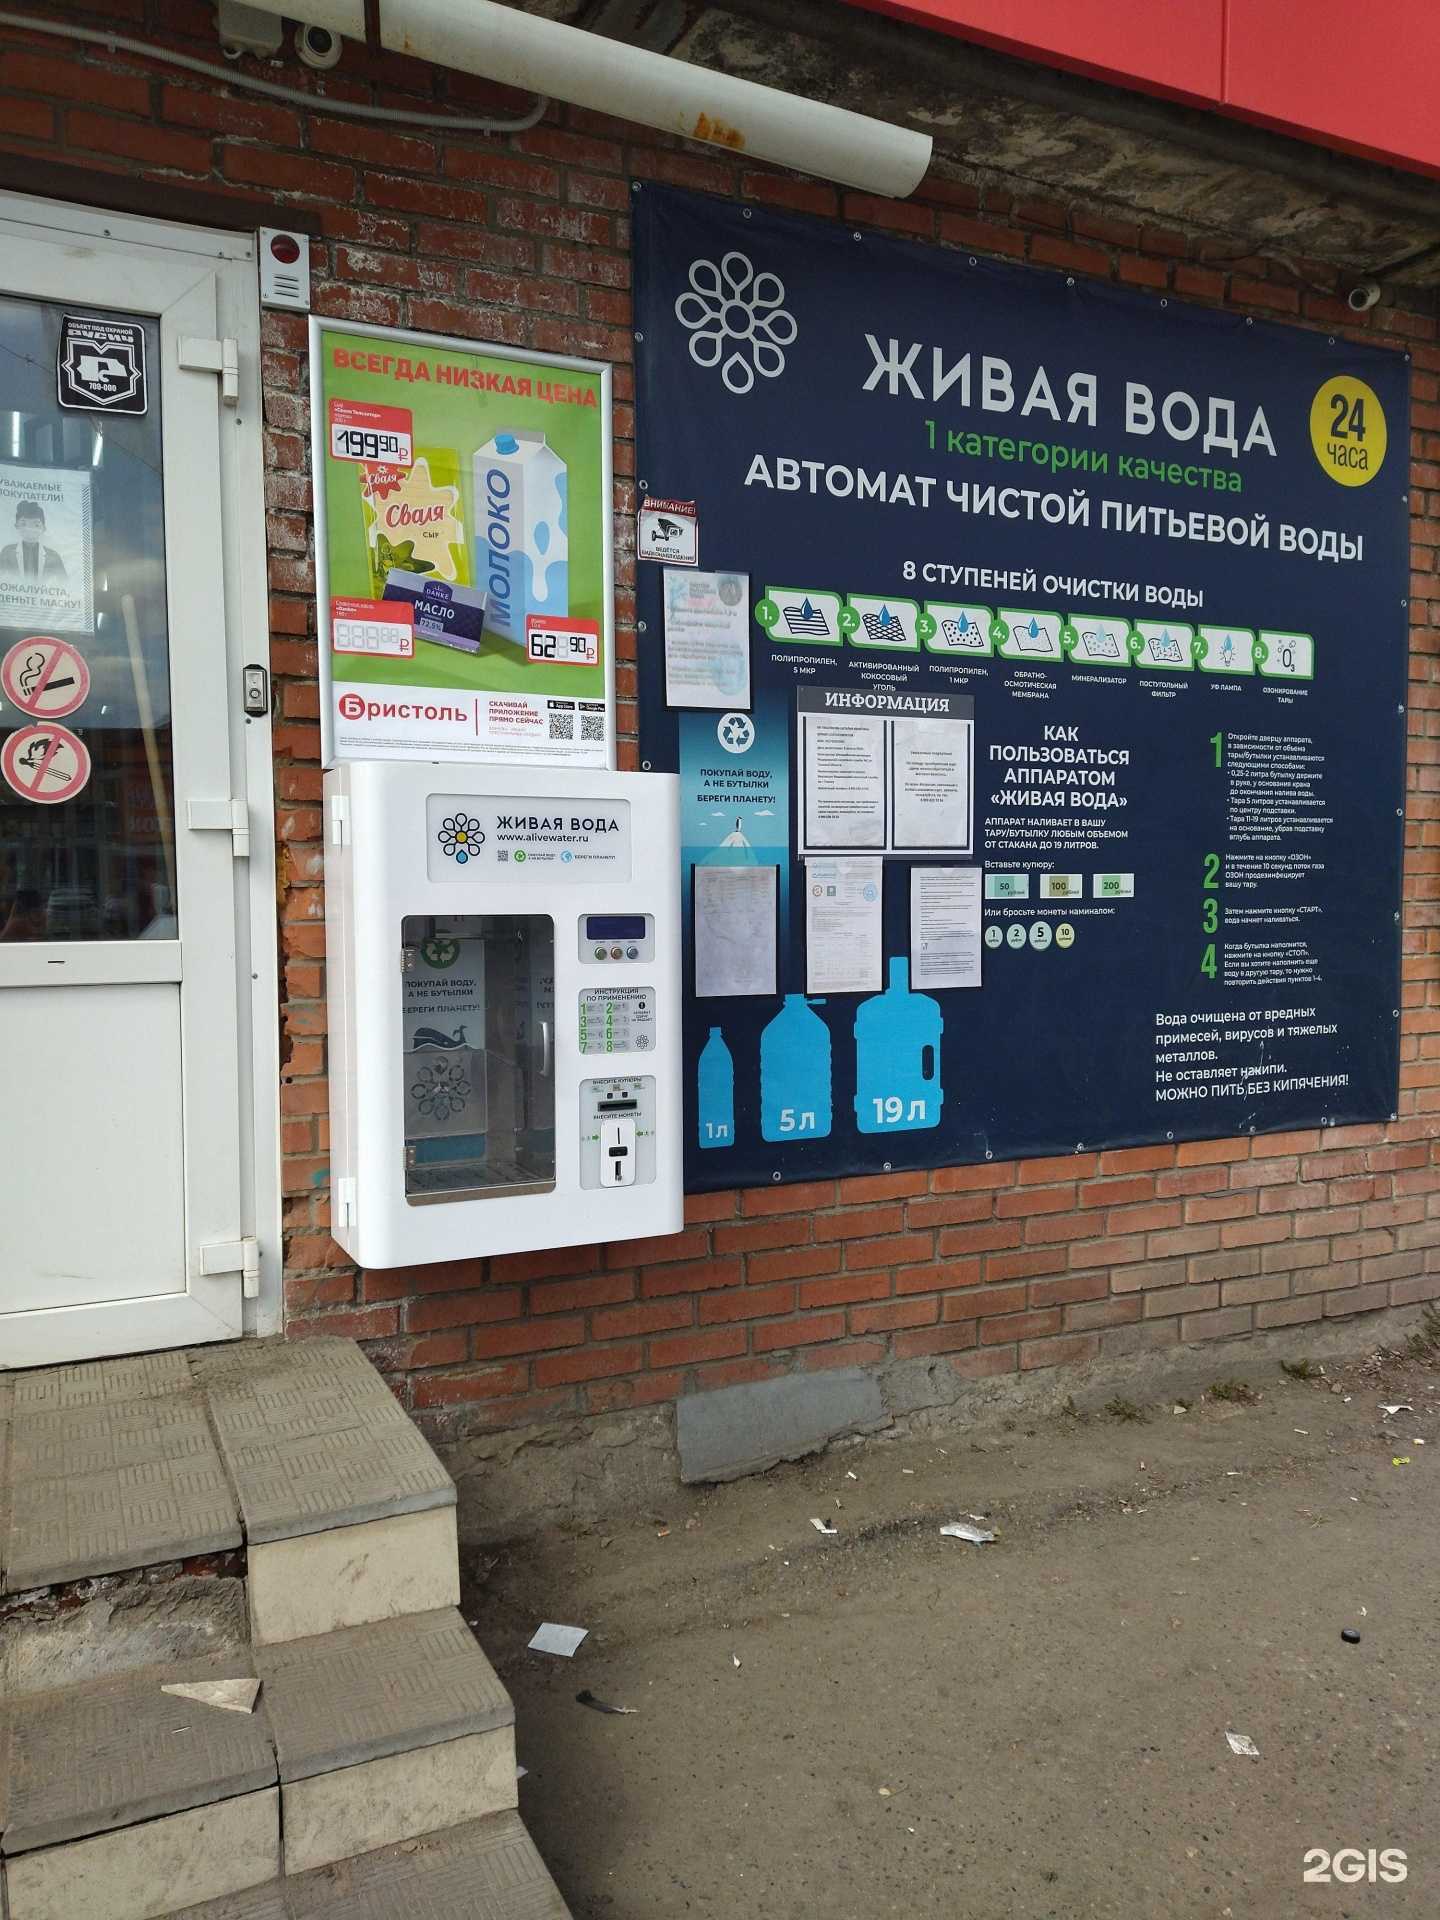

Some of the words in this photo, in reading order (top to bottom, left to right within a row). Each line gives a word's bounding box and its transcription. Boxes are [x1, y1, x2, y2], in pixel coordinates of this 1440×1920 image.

[105, 327, 132, 335] ОХРАНОЙ
[333, 348, 430, 382] ВСЕГДА
[436, 366, 530, 397] НИЗКАЯ
[537, 382, 598, 408] ЦЕНА
[862, 333, 1097, 427] ЖИВАЯ
[1125, 381, 1277, 458] ВОДА
[1330, 394, 1366, 442] 24
[925, 420, 936, 450] 1
[947, 430, 1109, 475] категории
[1118, 454, 1243, 494] качества
[1326, 442, 1368, 471] часа
[644, 499, 695, 514] ВНИМАНИЕ!
[744, 454, 937, 508] АВТОМАТ
[946, 480, 1090, 527] ЧИСТОЙ
[1101, 499, 1270, 549] ПИТЬЕВОЙ
[1279, 524, 1364, 563] ВОДЫ
[386, 504, 444, 528] Сваля
[487, 468, 511, 628] МОЛОКО
[0, 582, 70, 597] ОЖАЛУЙСТА,
[903, 561, 916, 580] 8
[922, 562, 1037, 592] СТУПЕНЕЙ
[1043, 574, 1139, 602] ОЧИСТКИ
[1145, 584, 1204, 609] ВОДЫ
[40, 598, 81, 608] МАСКУ!
[415, 600, 454, 619] МАСЛО
[531, 634, 556, 658] 62
[570, 637, 586, 652] 90
[772, 654, 838, 666] ПОЛИПРОПИЛЕН,
[848, 661, 919, 673] АКТИВИРОВАННЫЙ
[929, 666, 989, 677] ПОЛИПРОПИЛЕН,
[861, 673, 907, 682] КОКОСОВЫЙ
[953, 677, 968, 685] МКР
[1072, 675, 1127, 685] МИНЕРАЛИЗАТОР
[873, 683, 896, 691] УГОЛЬ
[1004, 680, 1057, 690] ОСМОТИЧЕСКАЯ
[1139, 680, 1189, 690] ПОСТУГОЛЬНЫЙ
[1211, 683, 1220, 691] УФ
[1221, 684, 1242, 692] ЛАМПА
[1262, 687, 1308, 696] ОЗОНИРОВАНИЕ
[1012, 690, 1049, 699] МЕМБРАНА
[1151, 690, 1176, 698] ФИЛЬТР
[339, 693, 468, 722] Бристоль
[489, 700, 527, 708] СКАЧИВАЙ
[825, 692, 950, 713] ИНФОРМАЦИЯ
[1044, 725, 1079, 741] КАК
[990, 745, 1130, 765] ПОЛЬЗОВАТЬСЯ
[1210, 732, 1222, 767] 1
[701, 768, 743, 777] ПОКУПАЙ
[746, 770, 772, 779] ВОДУ,
[1004, 768, 1115, 786] АППАРАТОМ
[727, 780, 768, 788] БУТЫЛКИ
[733, 795, 775, 803] ПЛАНЕТУ!
[991, 790, 1065, 807] «ЖИВАЯ
[1070, 791, 1128, 810] ВОДА»
[497, 815, 562, 830] ЖИВАЯ
[571, 818, 619, 833] ВОДА
[985, 818, 1025, 826] АППАРАТ
[1028, 819, 1072, 827] НАЛИВАЕТ
[1082, 819, 1105, 827] ВАШУ
[497, 833, 588, 843] www.alivewater.ru
[985, 829, 1049, 838] ТАРУ/БУТЫЛКУ
[1051, 830, 1084, 838] ЛЮБЫМ
[1087, 830, 1128, 839] ОБЪЕМОМ
[985, 841, 996, 849] ОТ
[999, 841, 1038, 849] СТАКАНА
[1040, 841, 1052, 851] ДО
[985, 860, 1020, 868] Вставьте
[1023, 861, 1055, 871] купюру:
[1204, 853, 1220, 888] 2
[1104, 882, 1119, 890] 200
[985, 908, 1001, 916] Или
[1003, 908, 1035, 917] бросьте
[1203, 898, 1218, 933] 3
[992, 930, 995, 938] 1
[1014, 929, 1020, 937] 2
[1037, 927, 1044, 937] 5
[1201, 944, 1217, 979] 4
[1156, 1013, 1187, 1027] Вода
[1191, 1010, 1245, 1024] очищена
[1249, 1010, 1261, 1021] от
[1265, 1007, 1316, 1021] вредных
[1156, 1030, 1222, 1047] примесей,
[1225, 1027, 1274, 1043] вирусов
[1277, 1027, 1285, 1037] и
[1288, 1024, 1337, 1036] тяжелых
[1156, 1050, 1218, 1064] металлов.
[1156, 1070, 1172, 1083] Не
[1176, 1067, 1237, 1081] оставляет
[1241, 1063, 1287, 1077] накипи.
[1156, 1083, 1208, 1102] МОЖНО
[1211, 1083, 1244, 1097] ПИТЬ
[1248, 1081, 1270, 1095] БЕЗ
[1274, 1074, 1349, 1092] КИПЯЧЕНИЯ!
